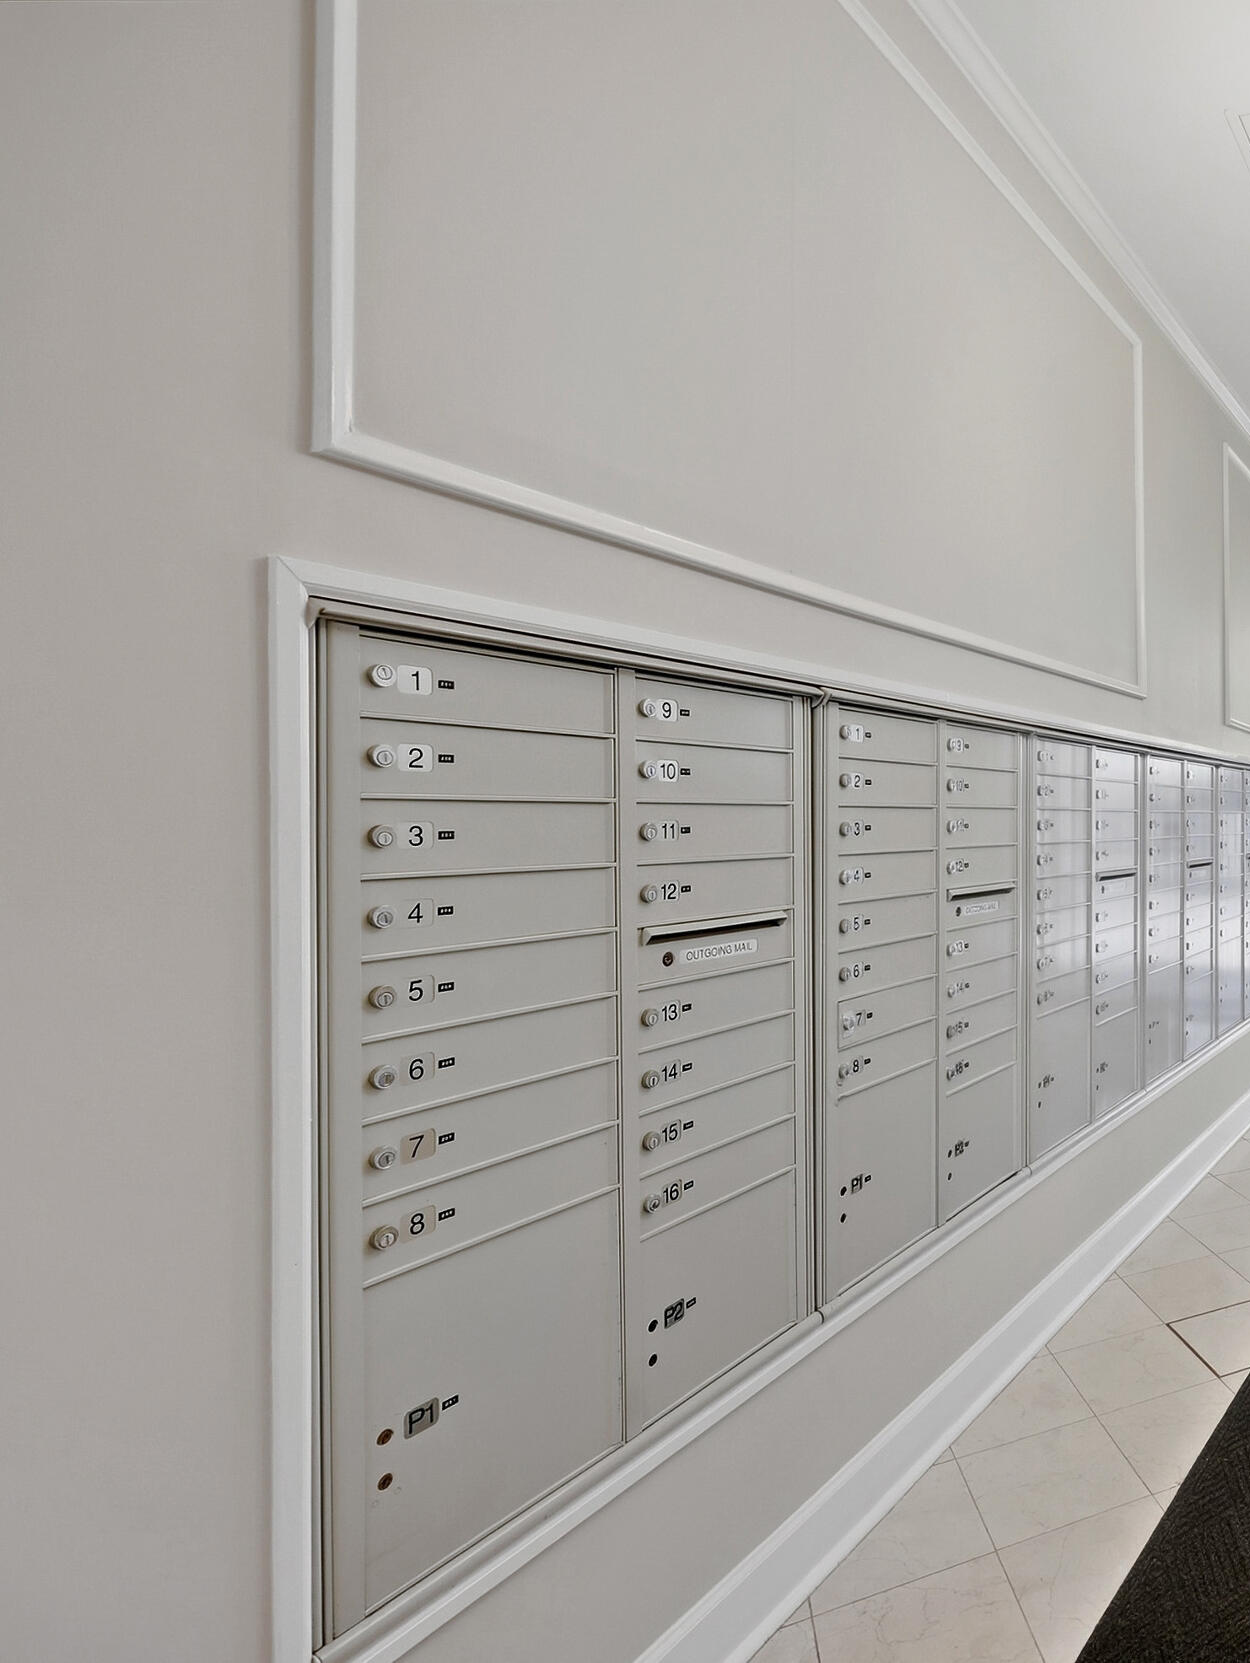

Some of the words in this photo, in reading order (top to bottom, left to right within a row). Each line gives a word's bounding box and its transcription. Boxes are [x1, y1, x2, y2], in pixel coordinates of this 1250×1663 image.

[410, 671, 420, 691] 1
[662, 702, 671, 719] 9
[855, 728, 860, 740] 1
[408, 748, 423, 768] 2
[660, 763, 676, 780] 10
[854, 775, 861, 788] 2
[408, 825, 423, 847] 3
[662, 823, 676, 840] 11
[854, 823, 861, 836] 3
[853, 870, 861, 882] 4
[660, 883, 677, 900] 12
[407, 902, 423, 924] 4
[853, 917, 860, 930] 5
[686, 945, 732, 961] OUTGOING
[734, 942, 752, 953] MAIL
[853, 964, 860, 978] 6
[408, 979, 423, 1002] 5
[662, 1003, 678, 1021] 13
[856, 1013, 863, 1026] 7
[409, 1058, 425, 1080] 6
[662, 1063, 678, 1082] 14
[852, 1060, 860, 1073] 8
[662, 1123, 678, 1143] 15
[409, 1134, 425, 1158] 7
[663, 1183, 679, 1204] 16
[851, 1174, 863, 1194] P1
[410, 1213, 425, 1235] 8
[664, 1301, 683, 1329] P2
[408, 1403, 433, 1434] P1
